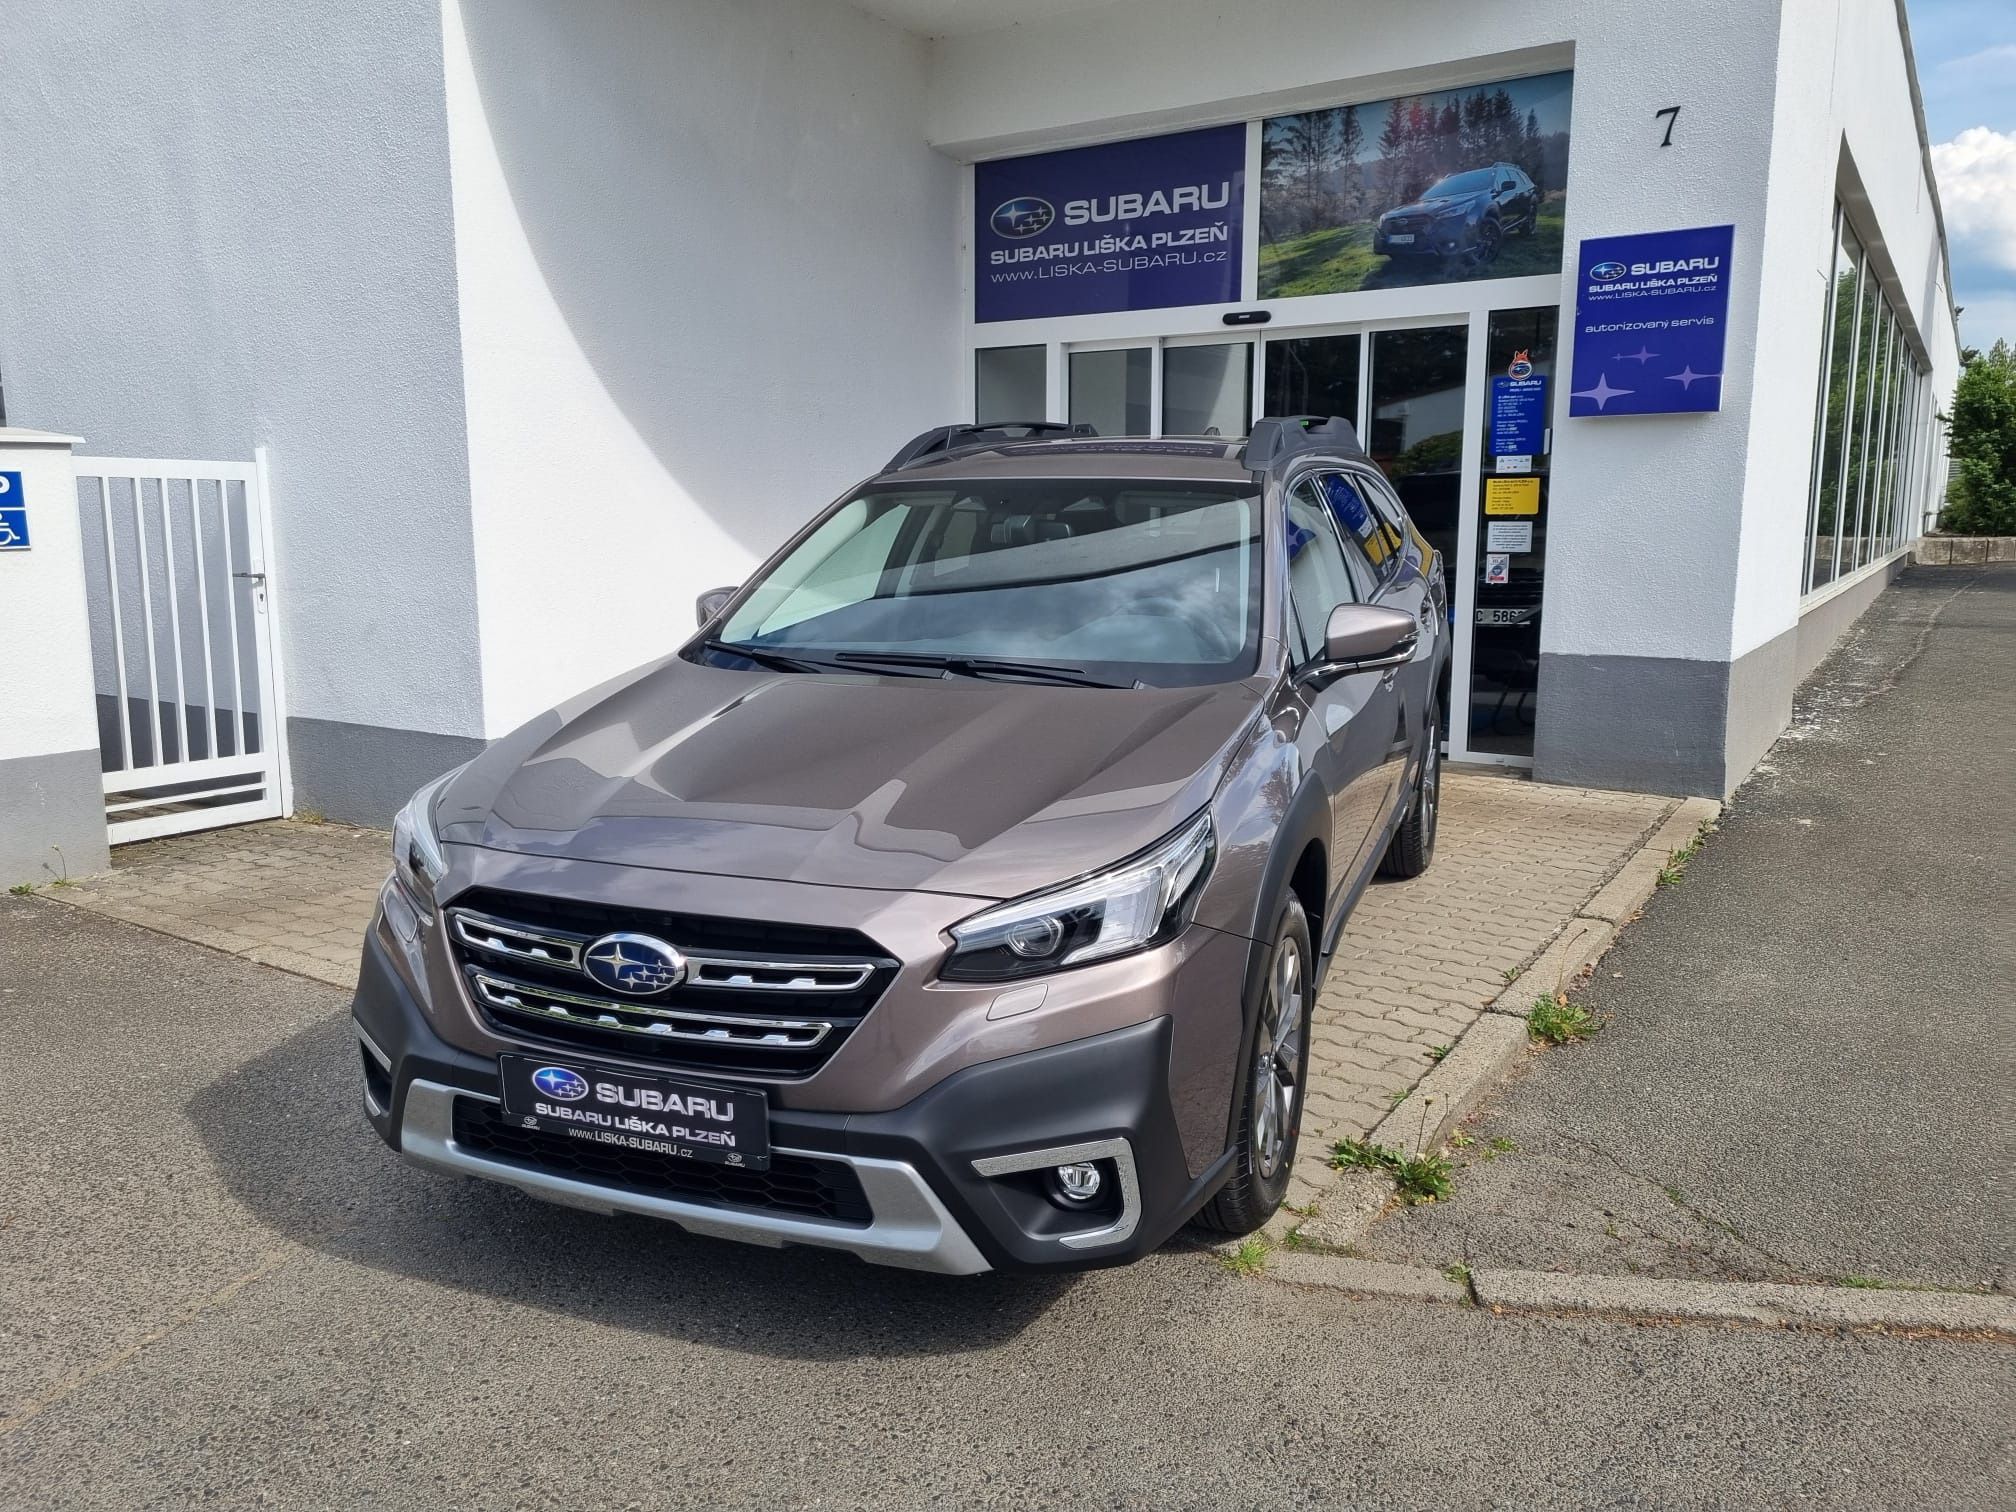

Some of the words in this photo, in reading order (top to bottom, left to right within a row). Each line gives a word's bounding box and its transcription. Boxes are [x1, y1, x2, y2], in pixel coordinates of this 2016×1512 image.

[1656, 105, 1681, 147] 7
[1064, 181, 1230, 226] SUBARU
[990, 241, 1079, 265] SUBARU
[1083, 234, 1147, 255] LIŠKA
[1152, 221, 1228, 249] PLZEŇ
[990, 250, 1228, 283] www.LISKA-SUBARU.cz
[1630, 256, 1720, 276] SUBARU
[1588, 281, 1639, 293] SUBARU
[1640, 278, 1676, 289] LIŠKA
[1677, 273, 1718, 286] PLZEŇ
[1588, 285, 1717, 301] www.LISKA-SUBARU.cz
[1585, 318, 1669, 333] autorizovaný
[1671, 315, 1714, 327] servis
[595, 1082, 734, 1122] SUBARU
[535, 1102, 612, 1127] SUBARU
[615, 1115, 670, 1137] LIŠKA
[672, 1126, 736, 1147] PLZEŇ
[568, 1127, 693, 1158] www.LISKA-SUBARU.cz
